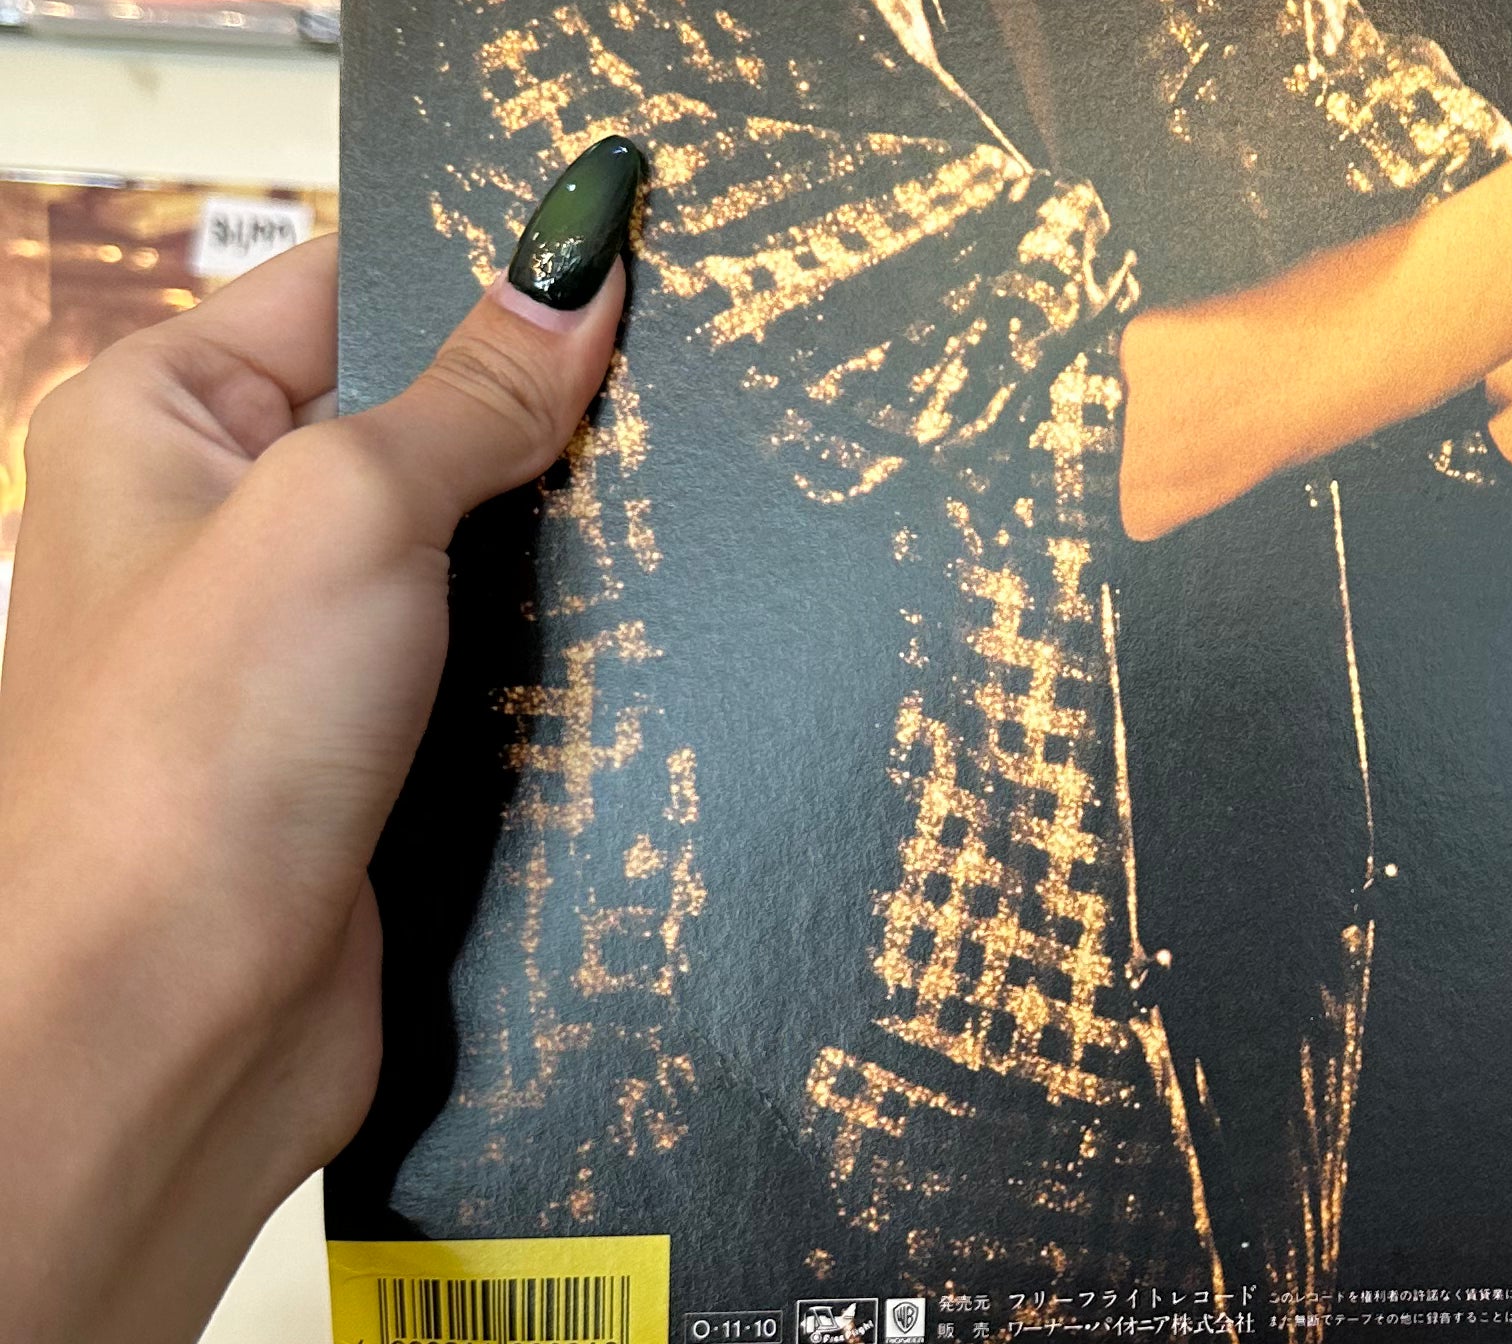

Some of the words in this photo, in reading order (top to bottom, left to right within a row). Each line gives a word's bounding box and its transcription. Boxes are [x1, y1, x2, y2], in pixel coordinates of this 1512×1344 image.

[1008, 1285, 1257, 1310] フリーフライトレコード
